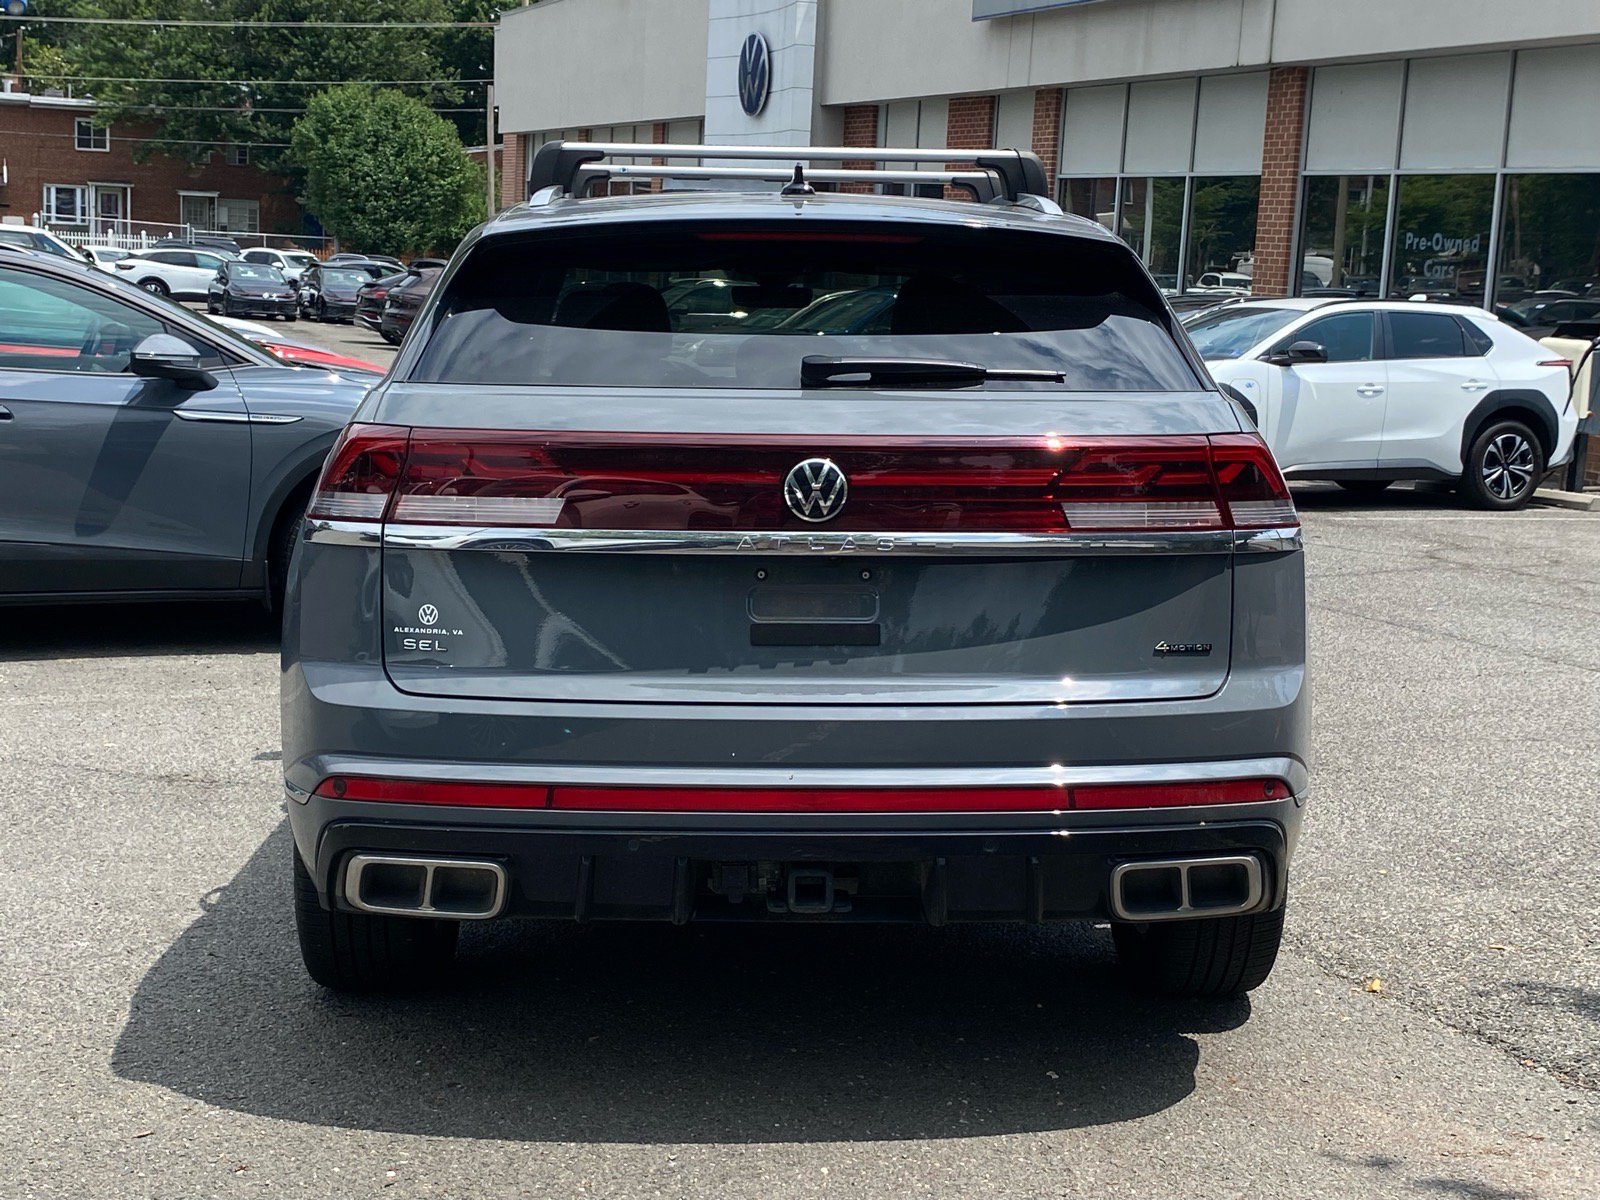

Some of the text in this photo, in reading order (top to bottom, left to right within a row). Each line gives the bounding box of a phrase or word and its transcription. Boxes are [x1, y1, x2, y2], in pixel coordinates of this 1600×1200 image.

[738, 31, 769, 116] VW
[1405, 232, 1480, 252] Pre-Owned
[1424, 259, 1455, 279] Cars
[784, 458, 848, 522] VW
[736, 536, 895, 551] ATLAS
[418, 604, 438, 625] VW
[394, 626, 450, 635] ALEXANDRIA,
[403, 638, 447, 651] SEL
[1154, 640, 1211, 652] 4MOTION
